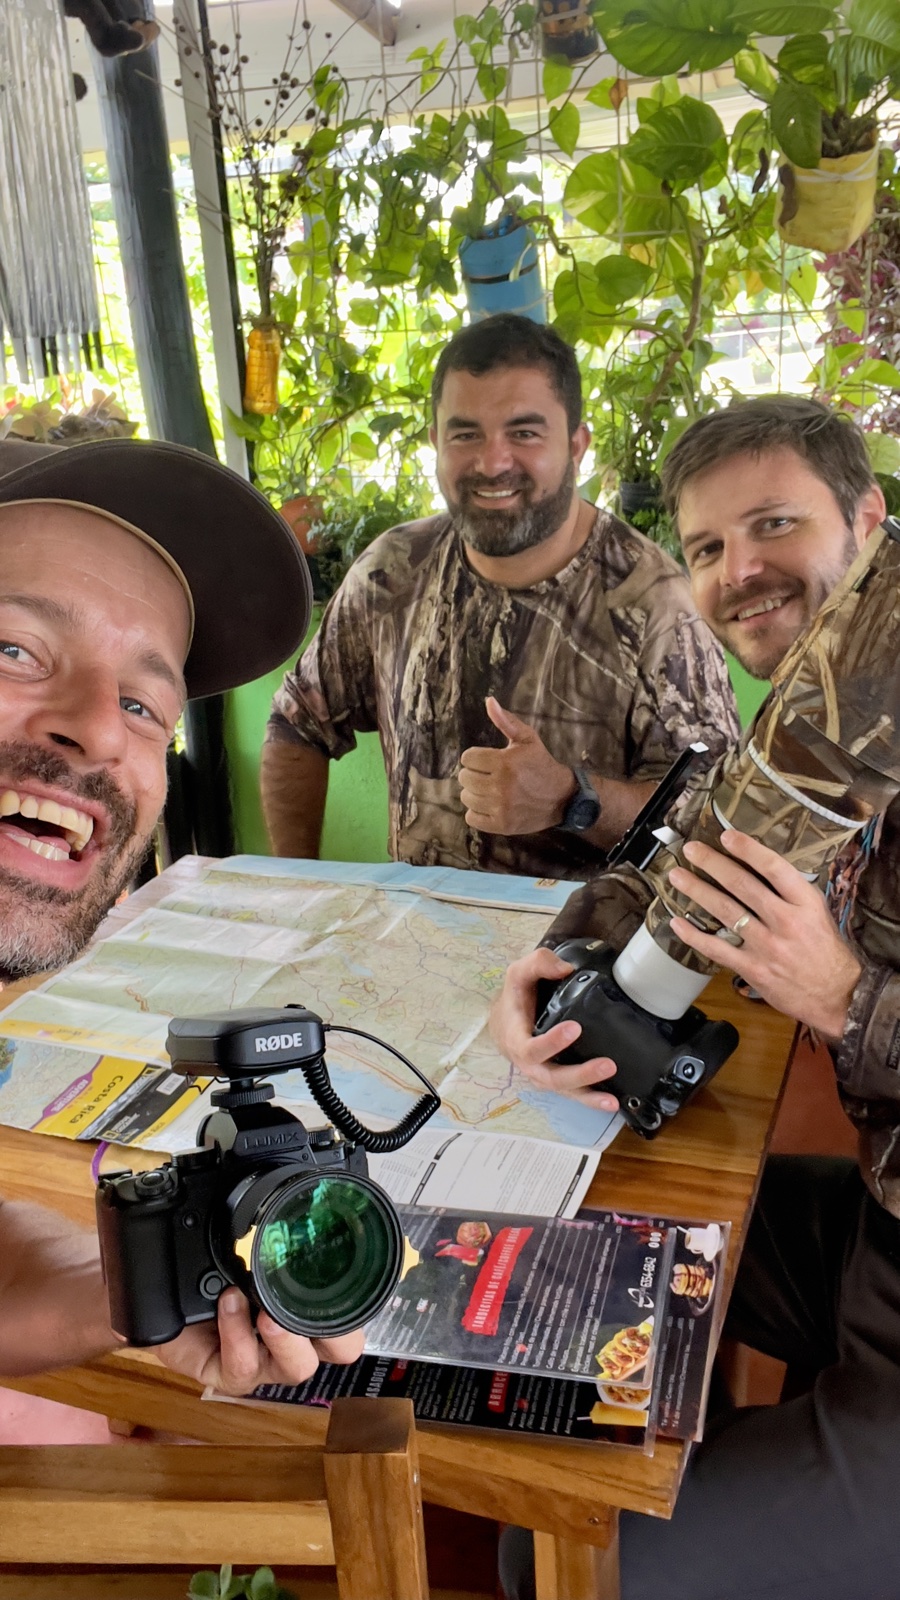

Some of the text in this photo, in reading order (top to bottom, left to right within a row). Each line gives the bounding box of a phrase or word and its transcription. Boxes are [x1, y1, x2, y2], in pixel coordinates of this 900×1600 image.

[255, 1032, 303, 1052] RØDE
[68, 1074, 124, 1123] Costa Rica
[244, 1131, 300, 1149] LUMIX
